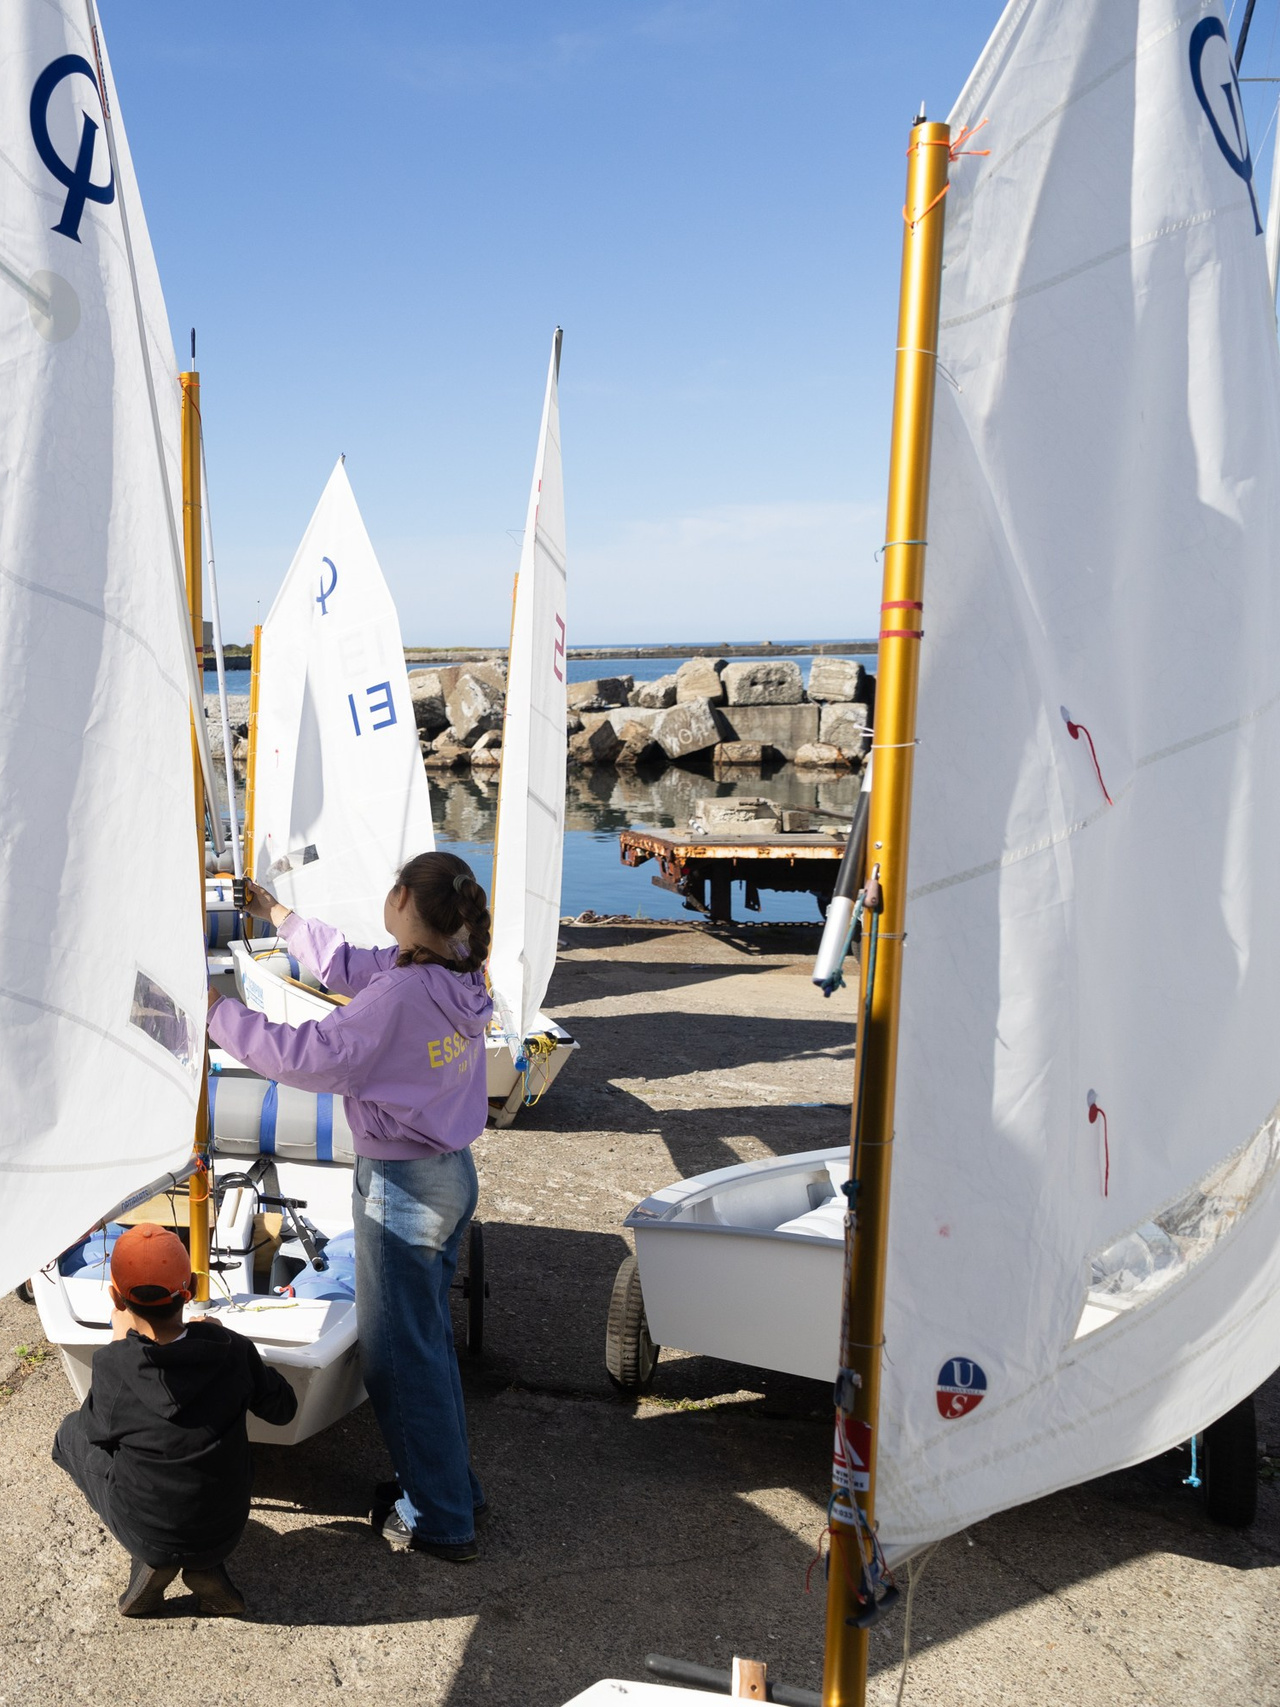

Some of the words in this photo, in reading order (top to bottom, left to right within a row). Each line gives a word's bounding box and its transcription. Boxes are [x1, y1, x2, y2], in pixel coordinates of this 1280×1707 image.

[348, 680, 398, 737] 13
[950, 1359, 974, 1388] U
[945, 1394, 968, 1418] S
